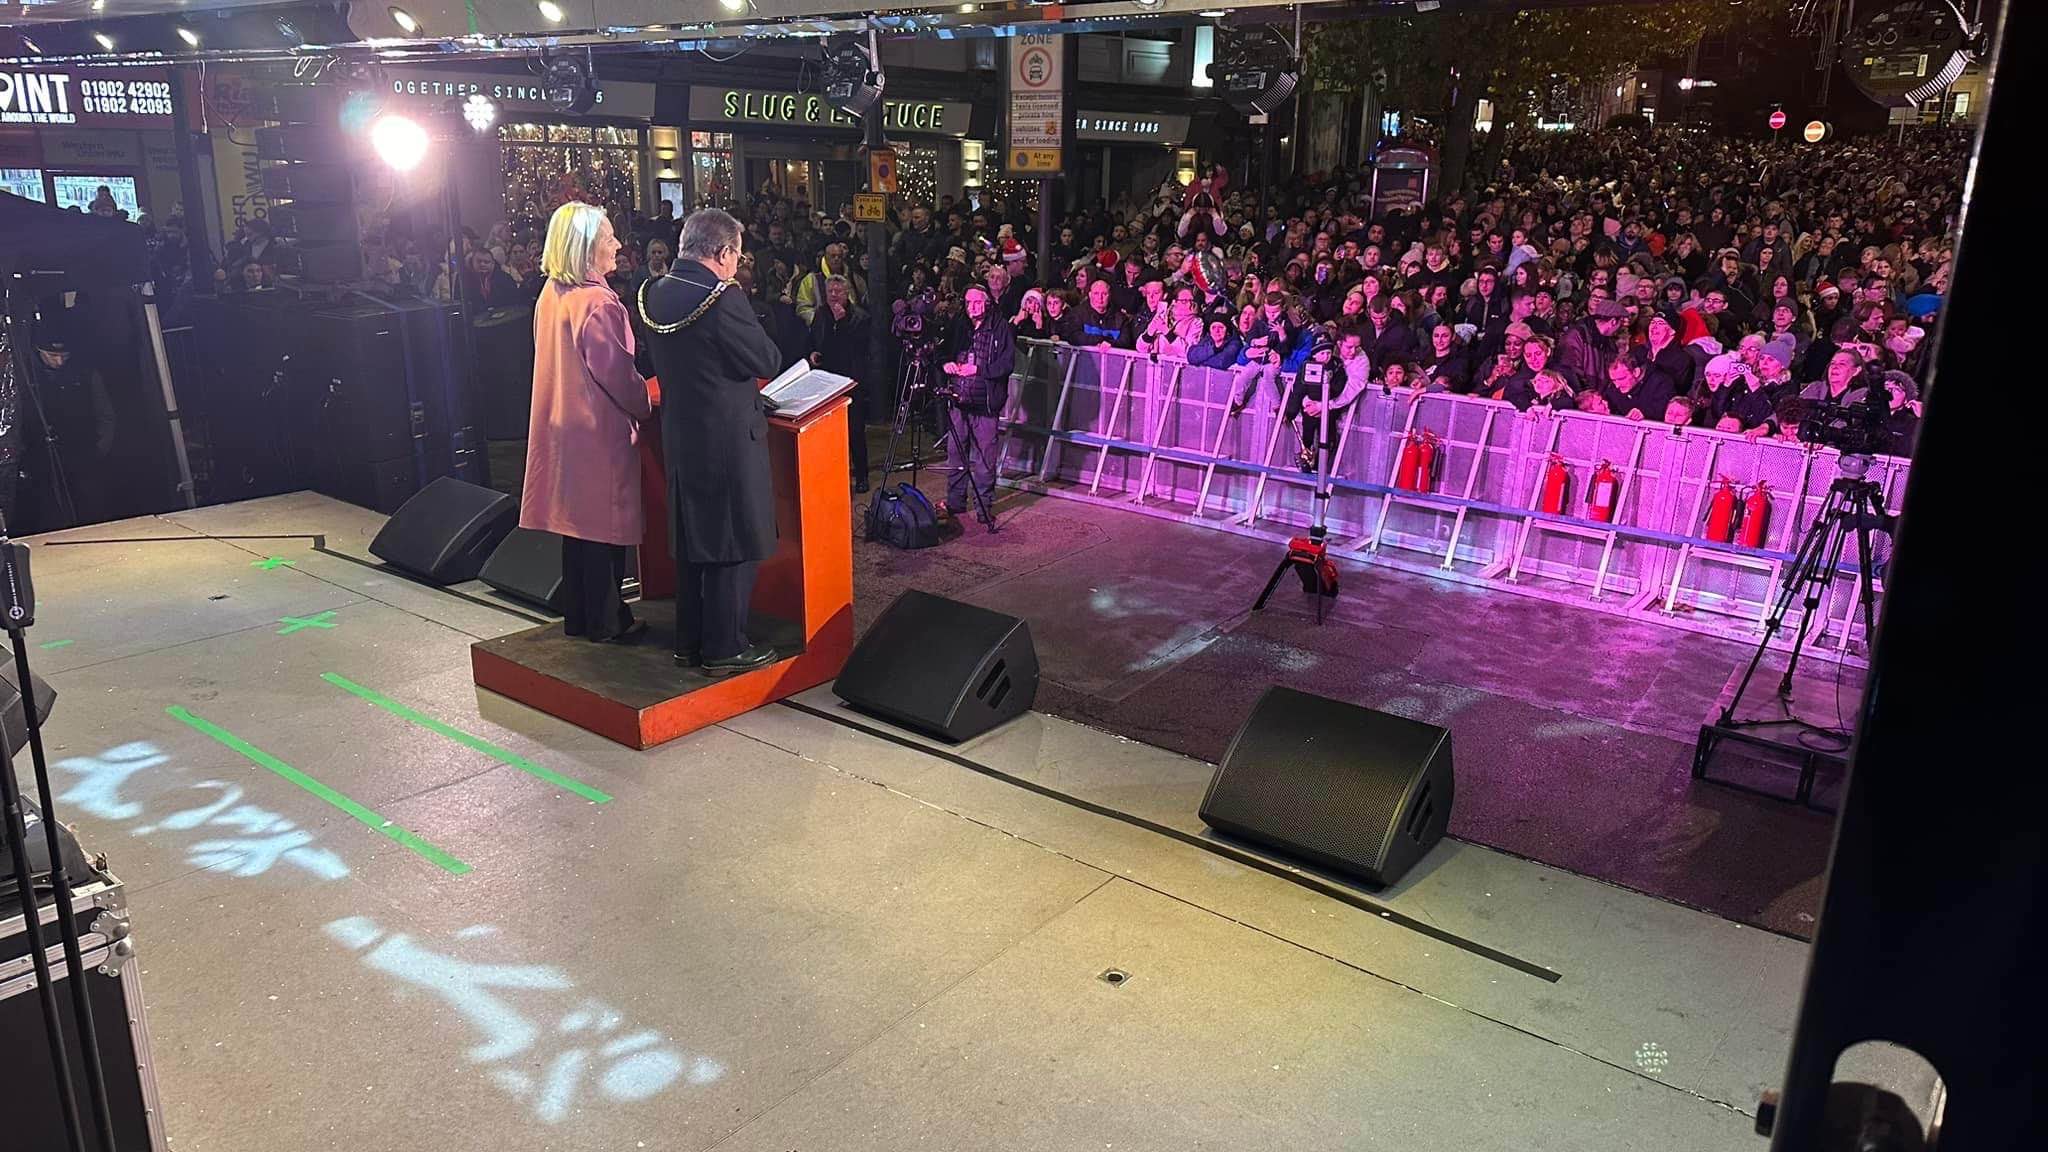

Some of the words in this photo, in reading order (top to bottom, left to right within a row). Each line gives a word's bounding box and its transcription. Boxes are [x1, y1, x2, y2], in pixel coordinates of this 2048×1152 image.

[1020, 33, 1053, 46] ZONE
[80, 79, 126, 97] 01902
[83, 96, 128, 113] 01902
[129, 98, 173, 115] 42093
[723, 91, 797, 122] SLUG
[804, 96, 821, 123] &
[830, 102, 945, 129] LTUCE
[32, 112, 49, 123] THE
[48, 112, 76, 124] WORLD
[1094, 119, 1129, 132] SINCE
[1133, 121, 1160, 134] 1985
[1013, 136, 1025, 144] and
[1026, 136, 1035, 144] for
[1036, 136, 1060, 146] loading
[1033, 152, 1041, 160] At
